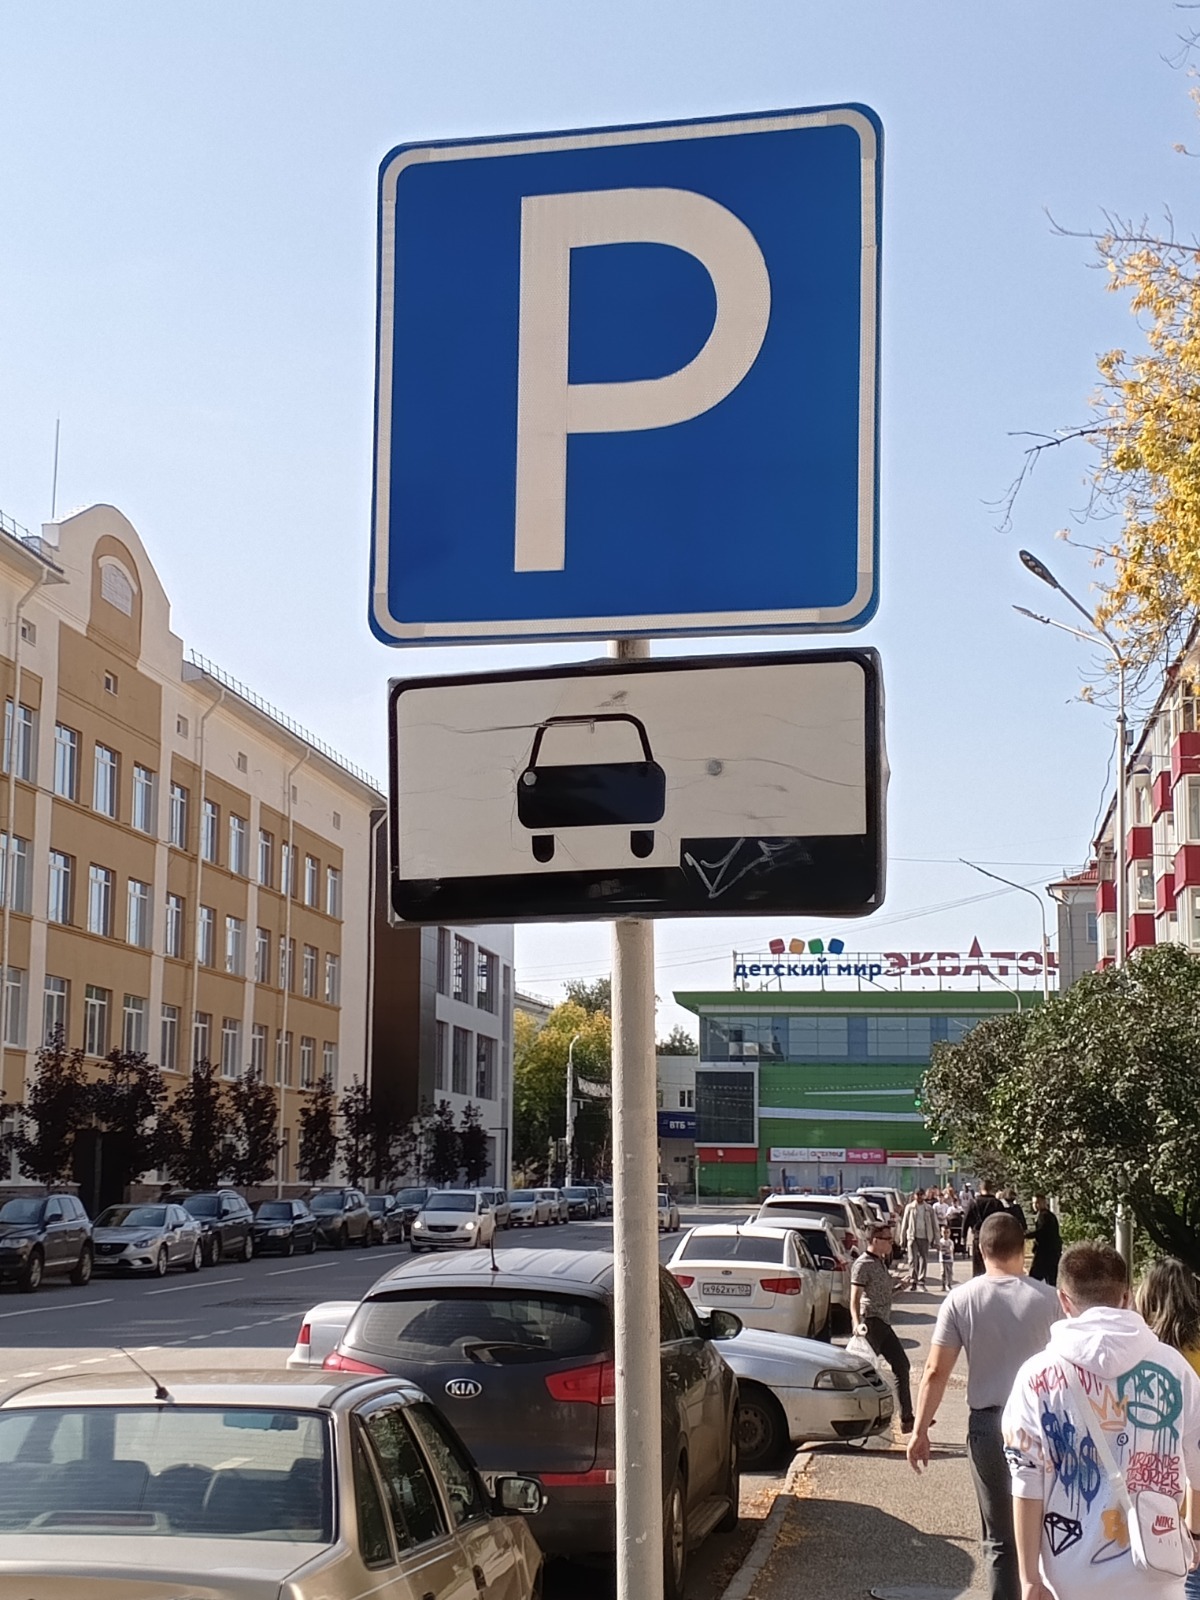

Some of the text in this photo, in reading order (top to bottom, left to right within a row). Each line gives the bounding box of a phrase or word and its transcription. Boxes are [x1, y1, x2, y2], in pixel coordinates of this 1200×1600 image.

[513, 187, 772, 573] P
[734, 957, 882, 984] детский мир
[669, 1120, 686, 1130] ВТБ
[451, 1383, 475, 1395] KIA
[1154, 1515, 1174, 1529] NIKE
